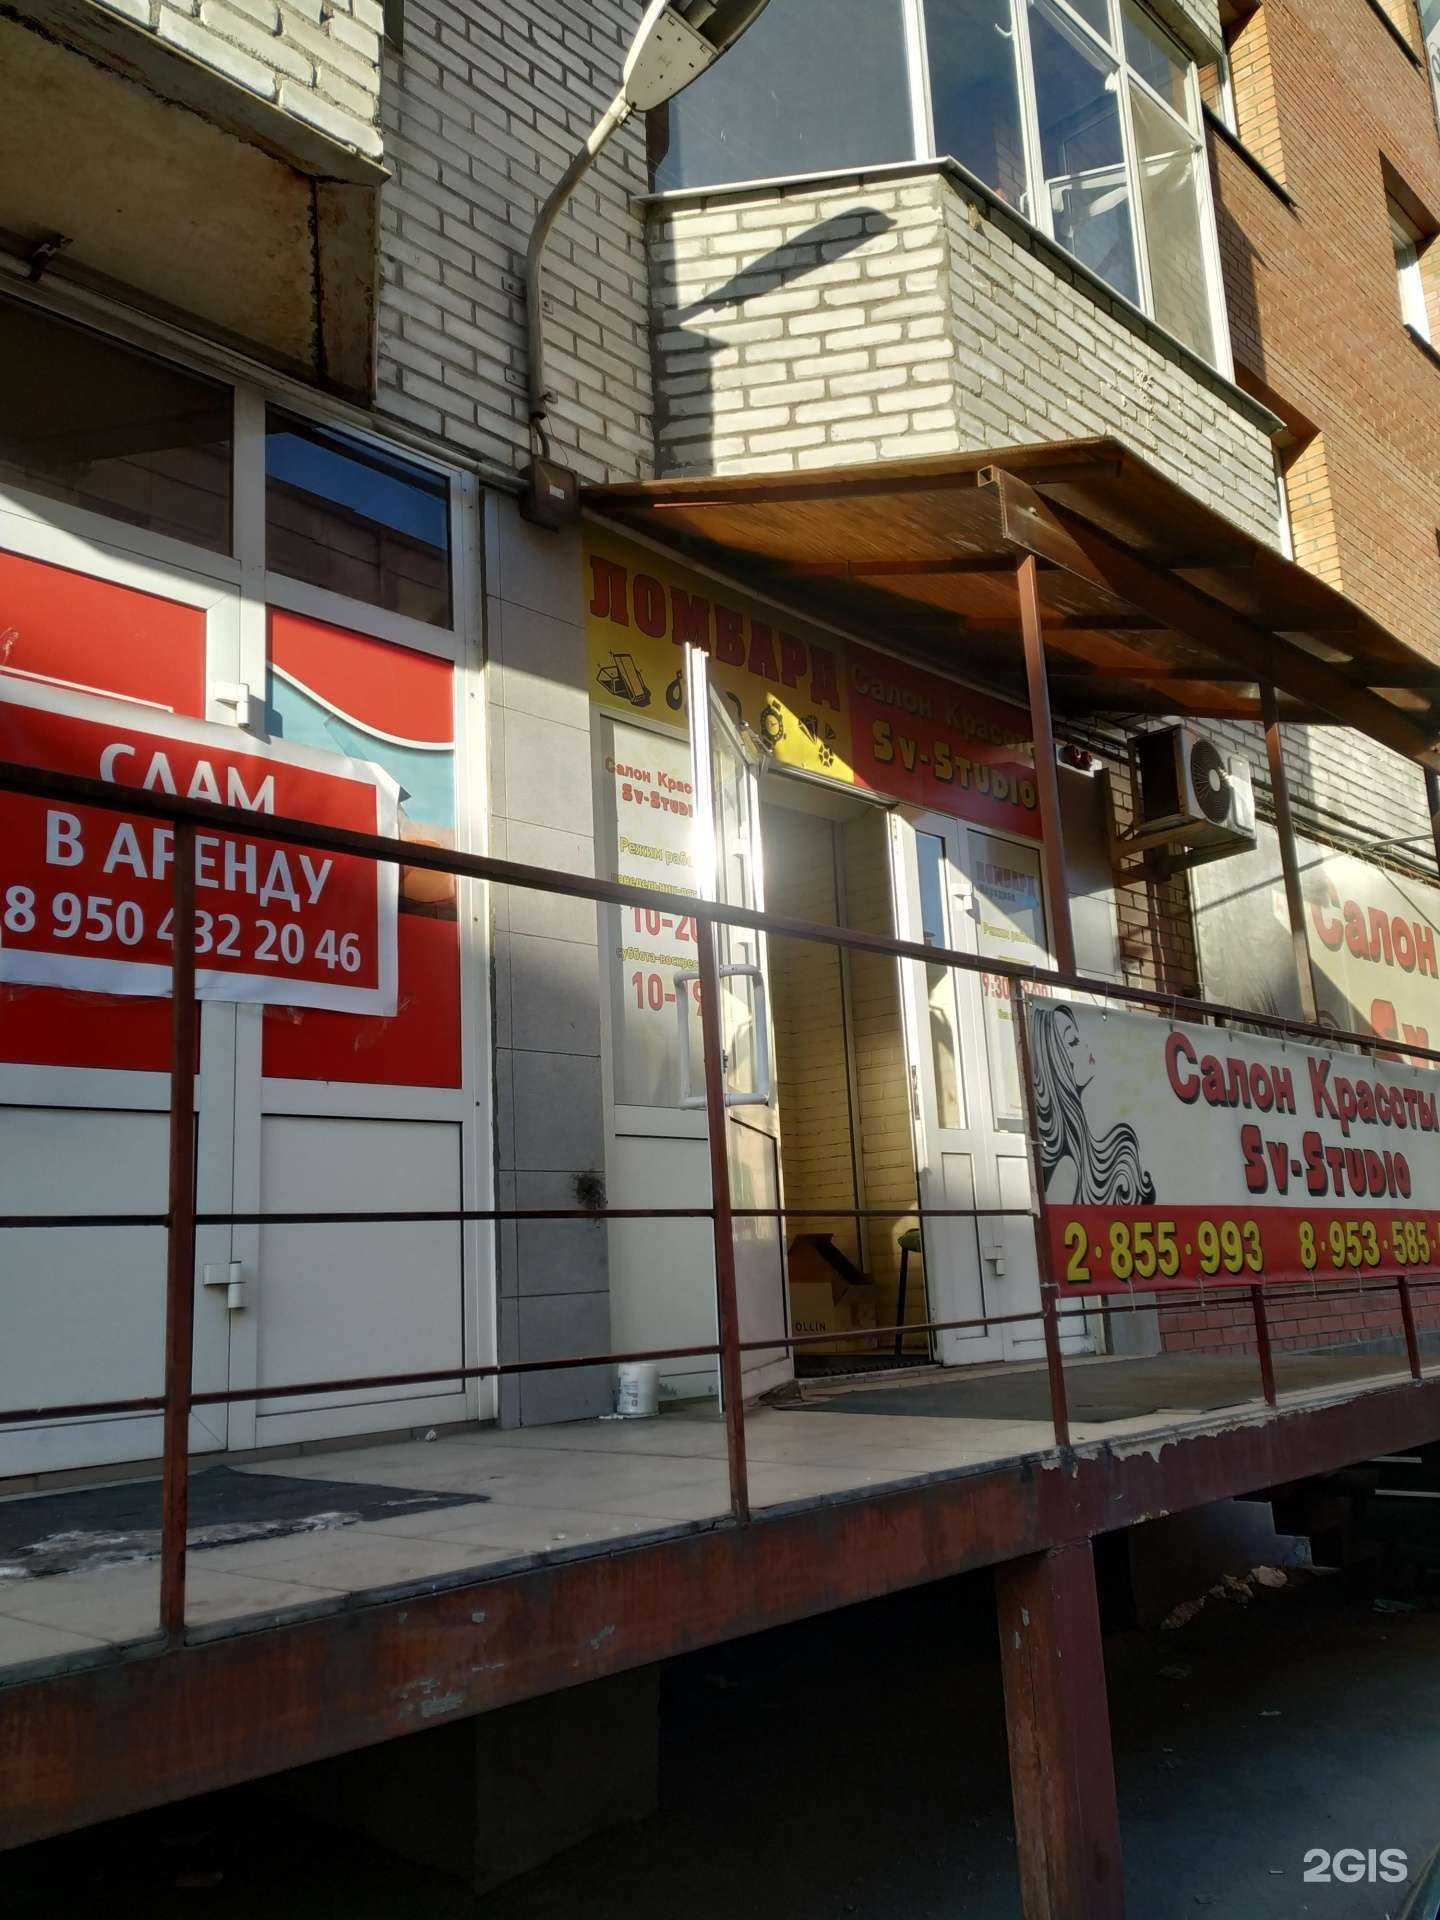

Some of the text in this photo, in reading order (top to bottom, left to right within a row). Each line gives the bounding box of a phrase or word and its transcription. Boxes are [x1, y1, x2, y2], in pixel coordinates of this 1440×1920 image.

[590, 554, 841, 712] ЛОМБАРД
[605, 757, 651, 783] Салон
[45, 809, 333, 912] В АРЕНДУ
[3, 885, 361, 973] 8 950 432 20 46
[1310, 866, 1439, 979] Салон
[632, 970, 704, 1020] 10-9
[1165, 1031, 1440, 1137] Салон Красоты
[794, 1321, 827, 1333] OLLIN
